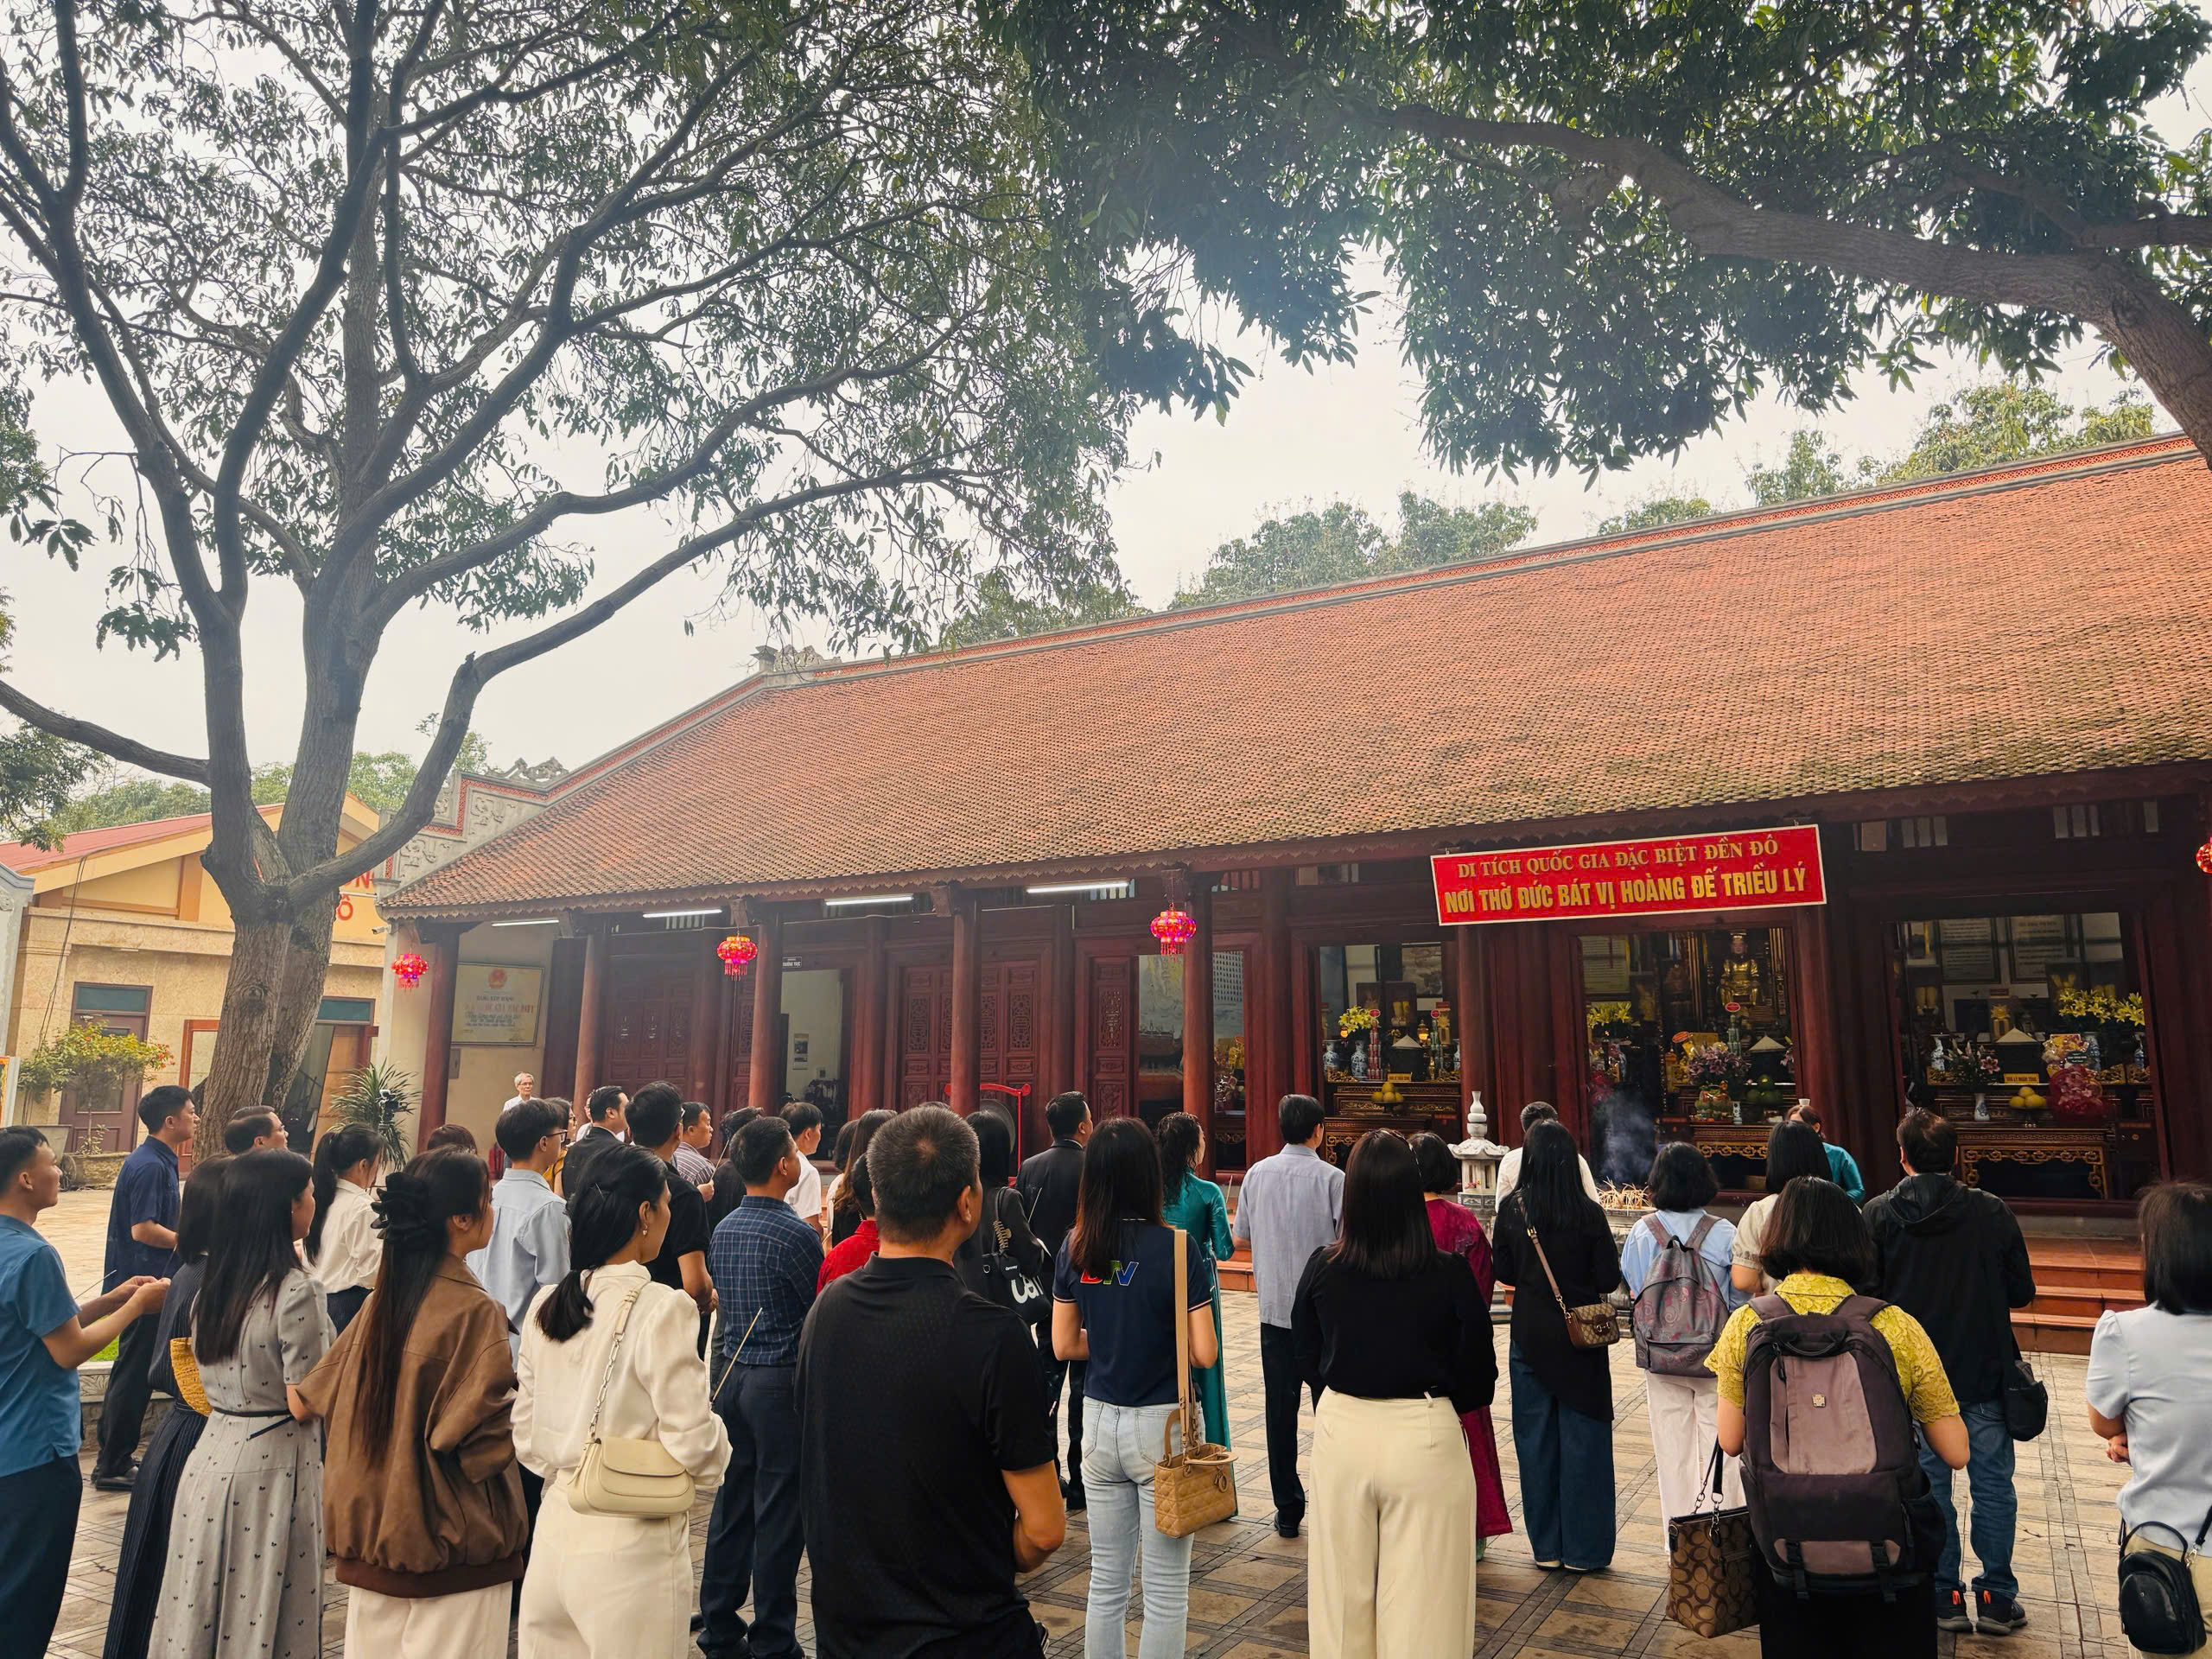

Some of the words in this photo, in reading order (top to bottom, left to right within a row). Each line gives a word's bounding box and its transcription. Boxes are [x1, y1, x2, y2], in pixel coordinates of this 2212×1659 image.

[1458, 863, 1476, 879] DI
[1479, 855, 1522, 877] TÍCH
[1527, 850, 1573, 875] QUỐC
[1579, 853, 1611, 869] GIA
[1615, 847, 1649, 871] ĐẶC
[1655, 842, 1697, 867] BIỆT
[1704, 836, 1743, 860] ĐỀN
[1750, 834, 1778, 856] ĐÔ
[1444, 887, 1475, 913] NƠI
[1478, 881, 1513, 912] THỜ
[1517, 880, 1554, 910] ĐỨC
[1557, 878, 1592, 907] BÁT
[1596, 881, 1616, 910] VỊ
[1620, 873, 1686, 904] HOÀNG
[1691, 866, 1719, 899] ĐẾ
[1721, 862, 1777, 897] TRIỀU
[1783, 861, 1806, 893] LÝ
